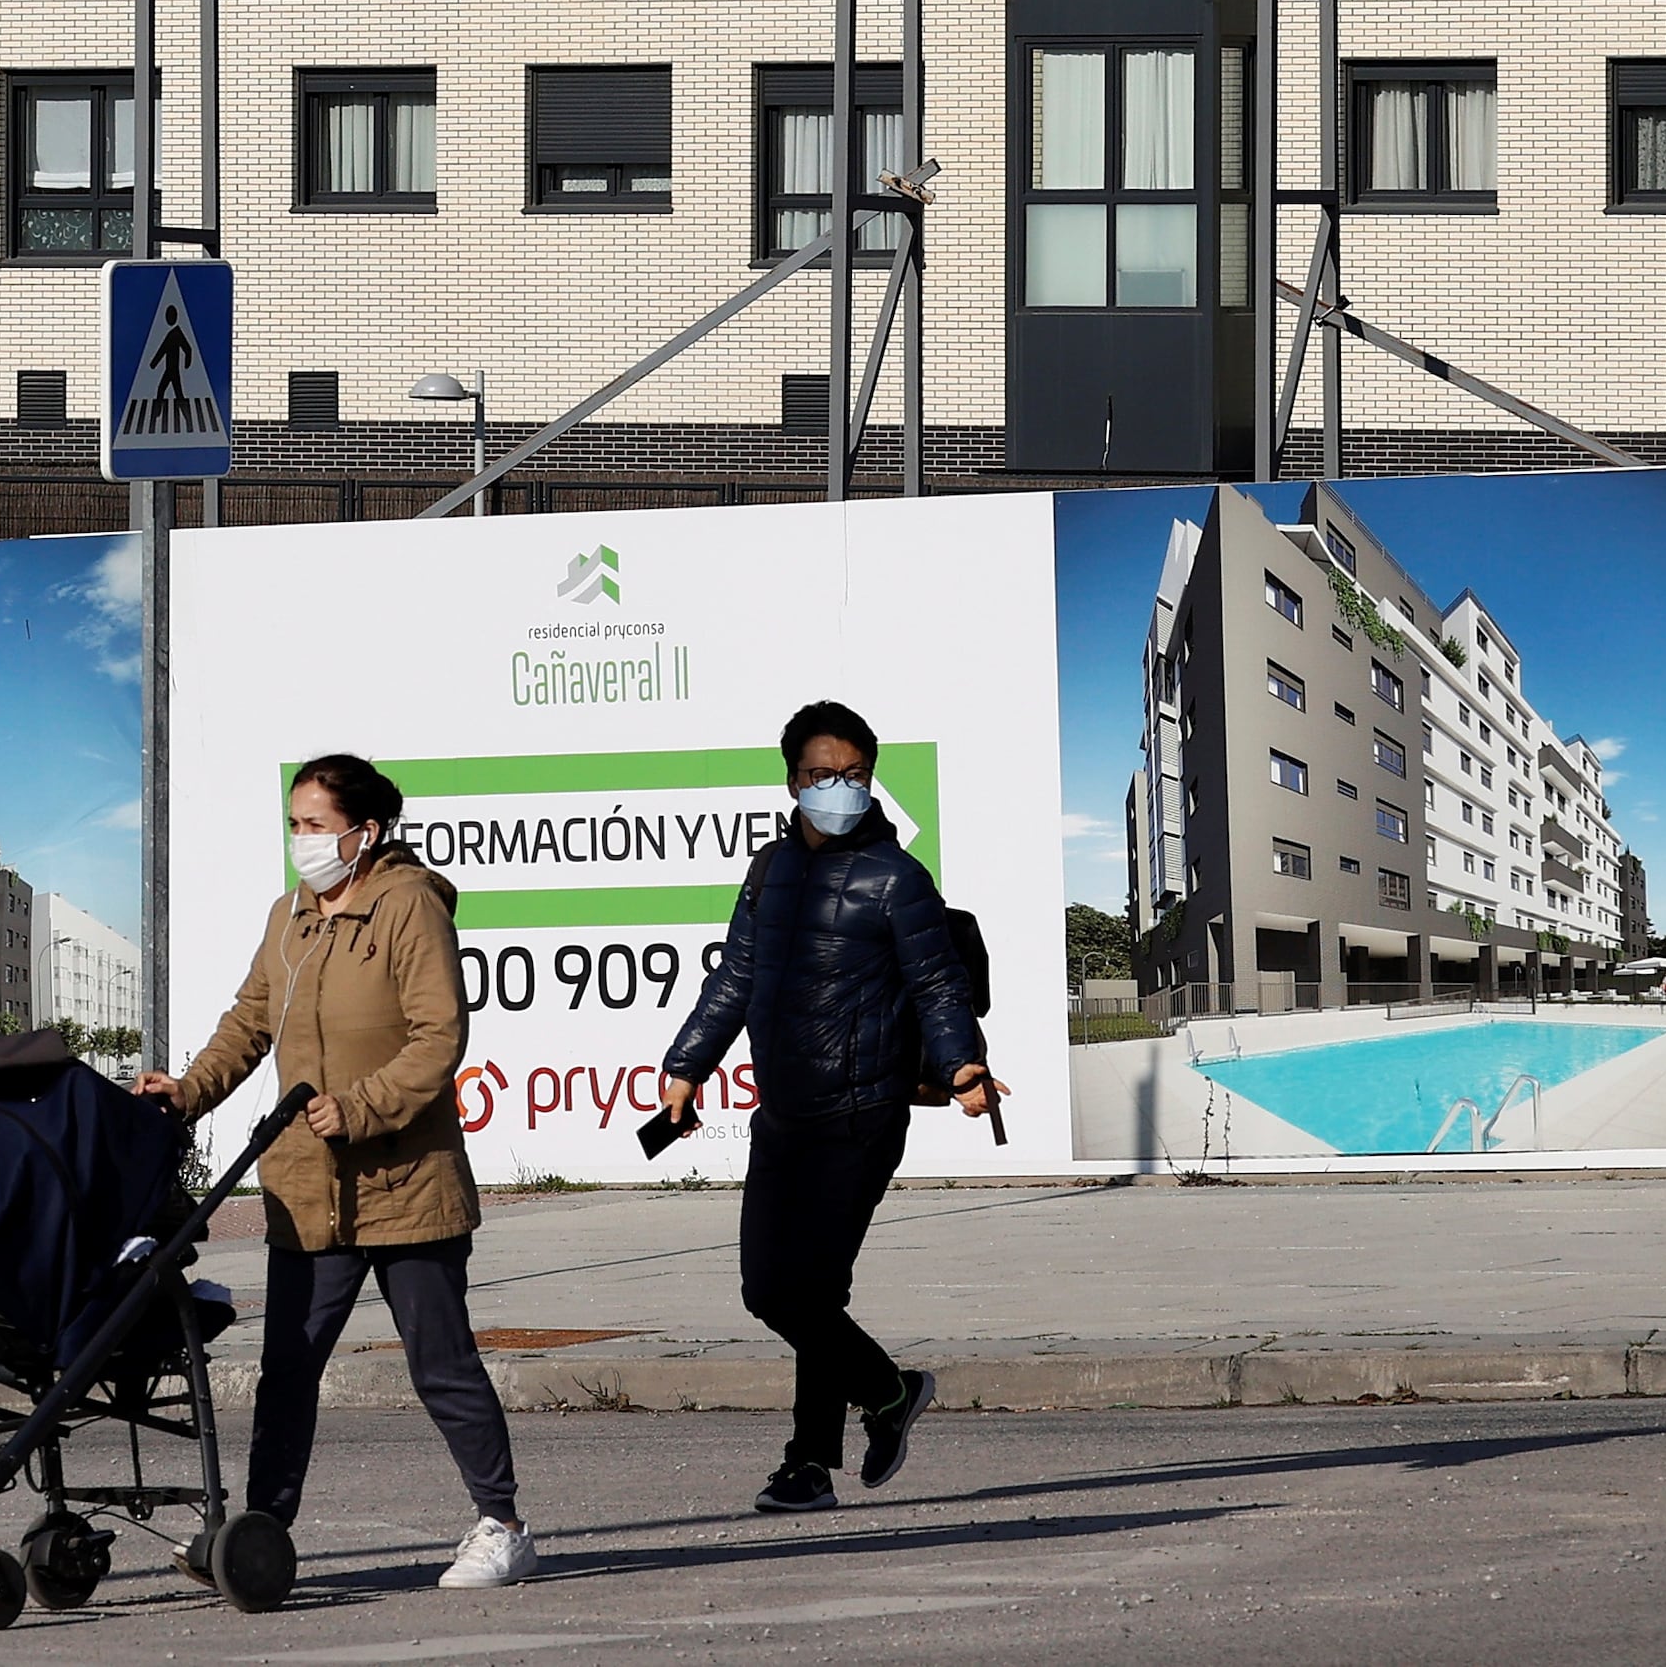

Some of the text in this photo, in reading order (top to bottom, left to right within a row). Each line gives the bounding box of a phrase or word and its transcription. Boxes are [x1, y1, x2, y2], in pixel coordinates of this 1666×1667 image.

[529, 622, 664, 639] residencial pryconsa
[513, 642, 660, 705] Cañaveral
[399, 805, 665, 867] FORMACIÓN
[675, 815, 706, 859] Y
[459, 946, 535, 1012] 00
[555, 943, 679, 1009] 909
[528, 1063, 761, 1130] prycns
